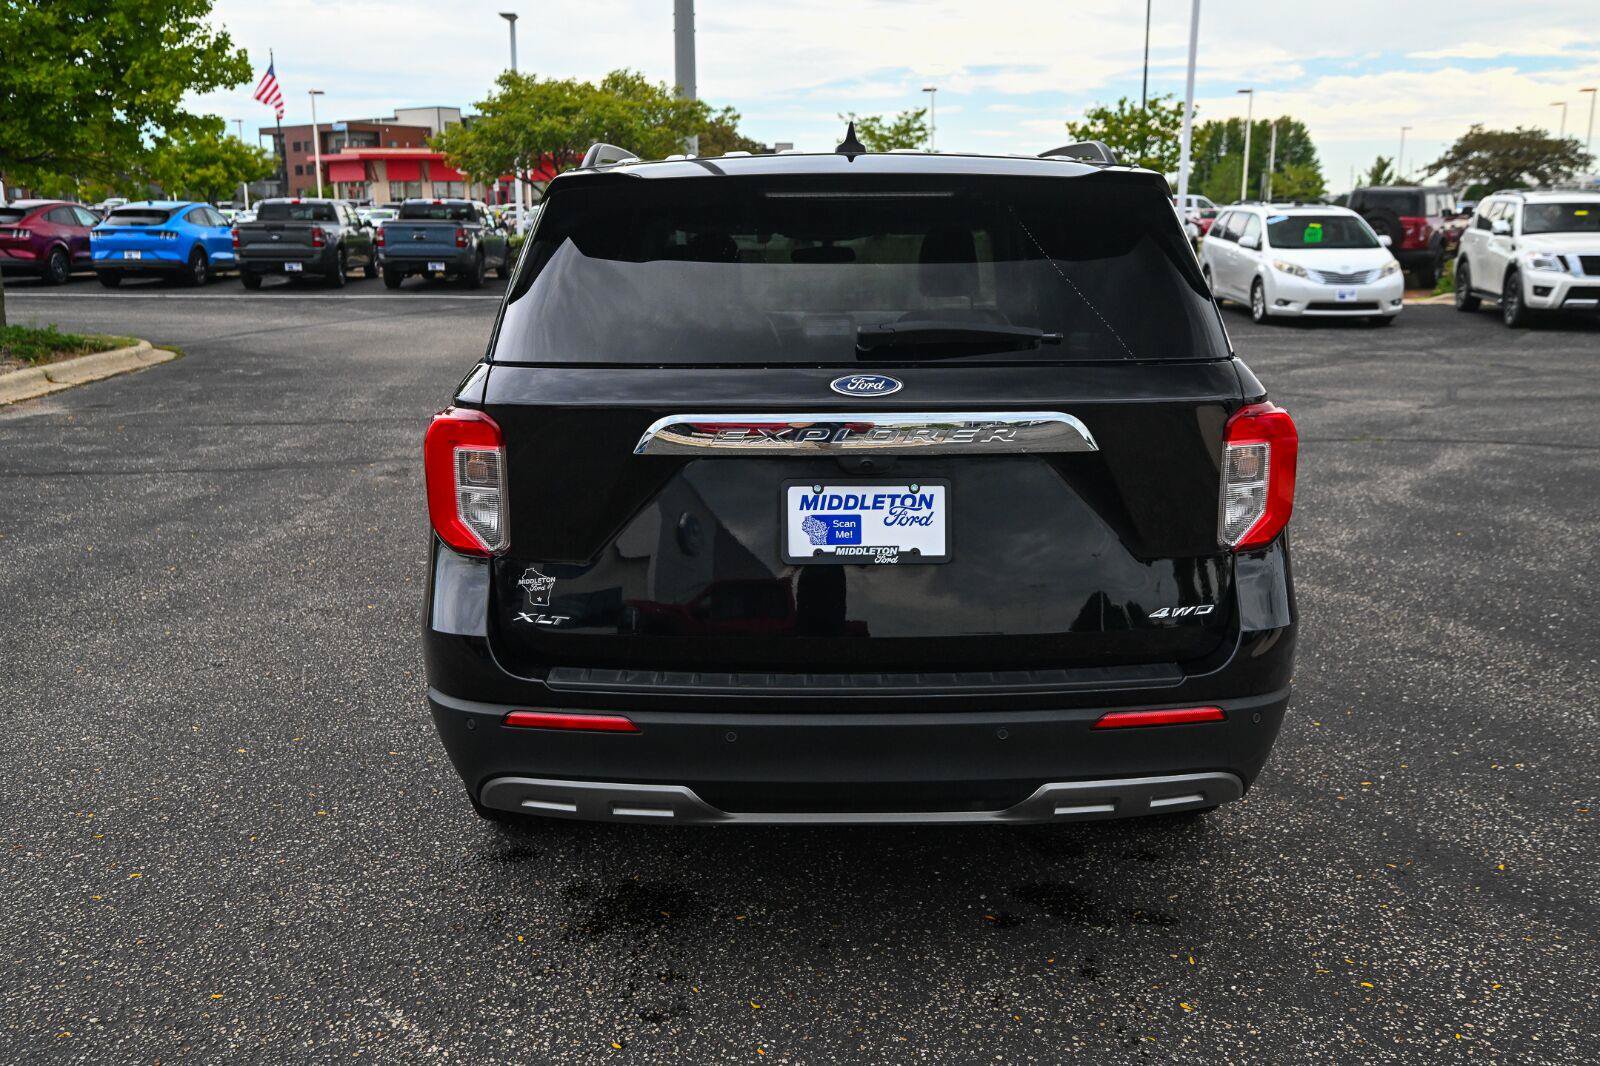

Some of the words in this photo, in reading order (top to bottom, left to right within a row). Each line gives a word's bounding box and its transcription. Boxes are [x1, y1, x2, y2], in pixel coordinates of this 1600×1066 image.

[847, 377, 885, 390] Ford
[711, 427, 1018, 445] EXPLORER
[799, 493, 935, 511] MIDDLETON
[884, 506, 935, 527] Ford
[832, 519, 856, 528] Scan
[835, 530, 853, 539] Me!
[836, 546, 899, 556] MIDDLETON
[874, 554, 899, 564] Ford
[517, 577, 556, 586] MIDDLETON
[1148, 604, 1215, 619] 4WD
[513, 612, 571, 625] XLT
